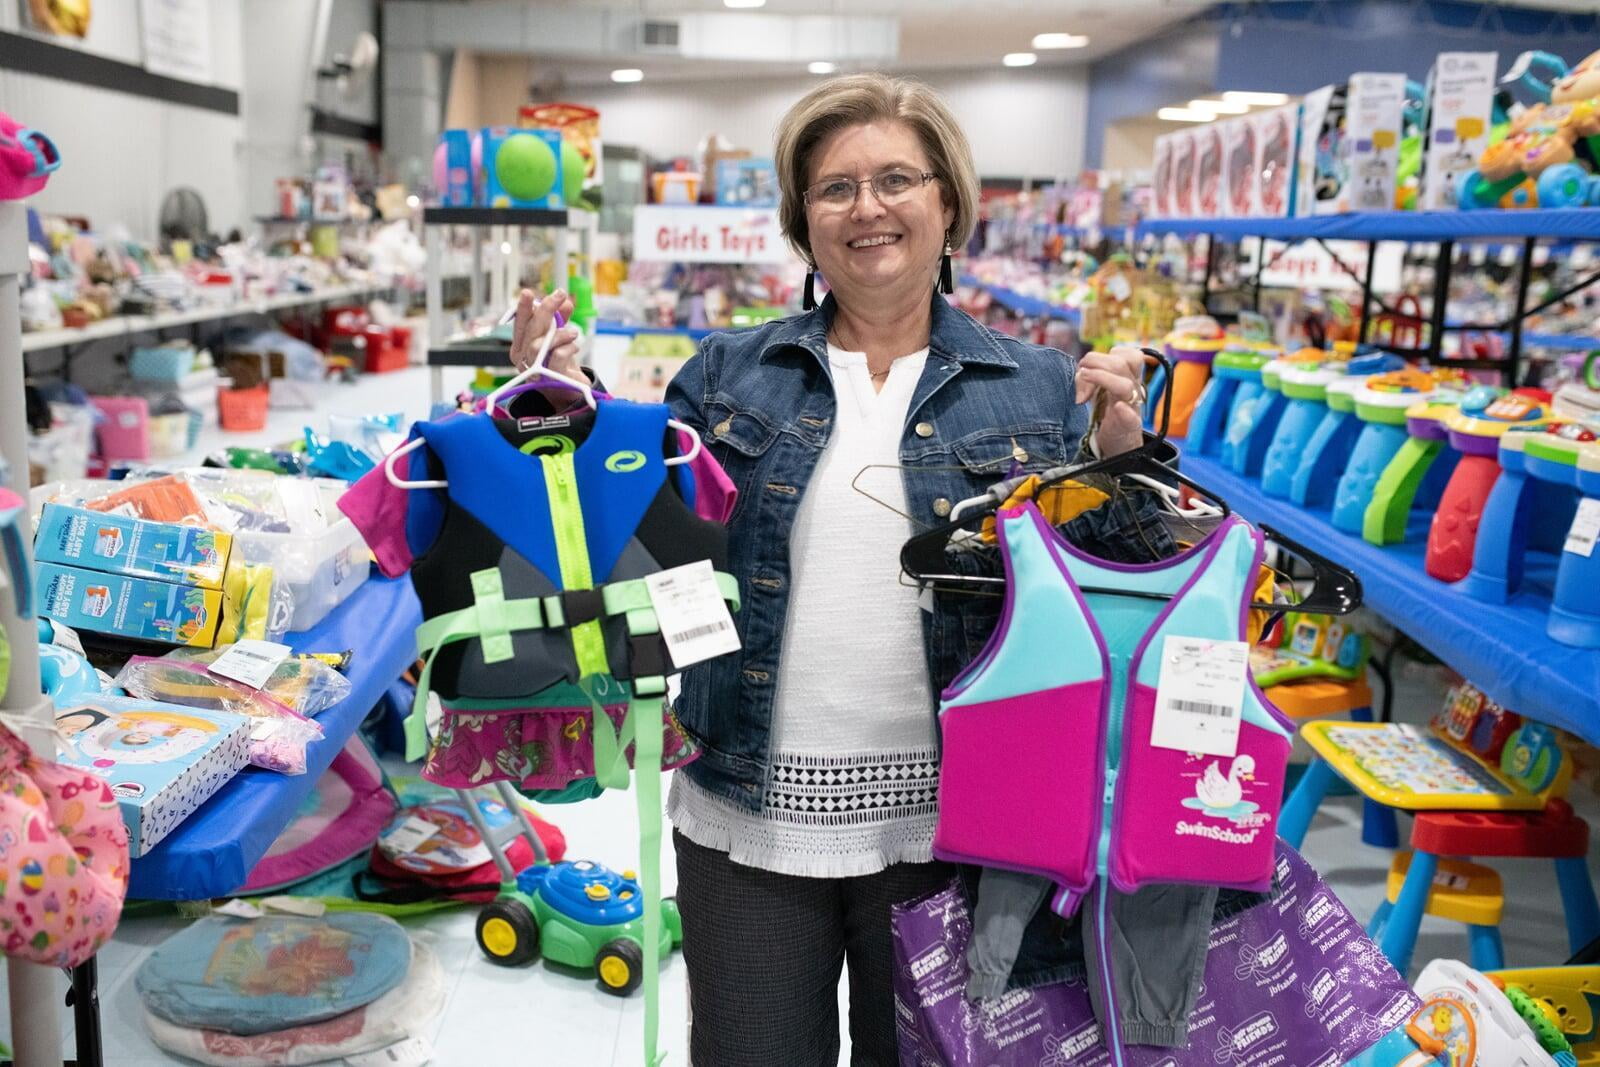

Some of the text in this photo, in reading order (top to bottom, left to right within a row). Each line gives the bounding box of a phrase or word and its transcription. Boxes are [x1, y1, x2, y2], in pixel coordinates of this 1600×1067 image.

[656, 225, 766, 259] Girls Toys
[72, 515, 88, 557] BABY BOAT
[60, 575, 75, 617] BABY BOAT
[1306, 903, 1334, 927] FRIENDS
[1320, 929, 1350, 954] jbfsale.com
[988, 992, 1029, 1019] FRIENDS
[996, 1023, 1041, 1049] jbfsale.com
[1235, 1023, 1273, 1050] FRIENDS
